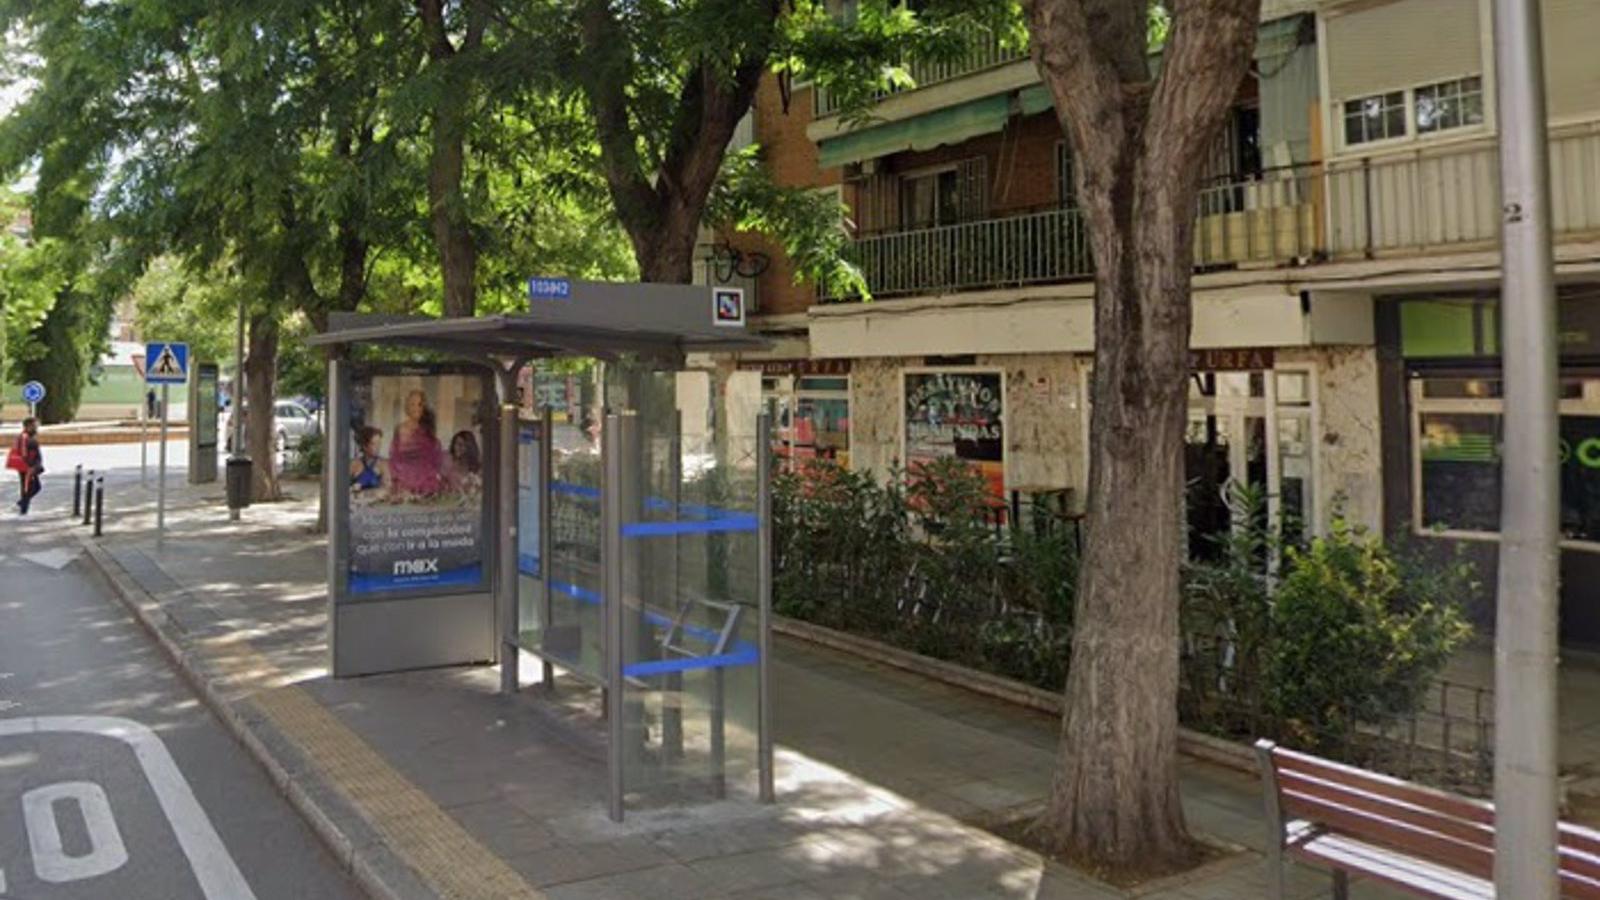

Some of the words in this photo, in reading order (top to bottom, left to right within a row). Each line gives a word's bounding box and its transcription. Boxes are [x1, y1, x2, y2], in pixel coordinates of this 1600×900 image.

[1503, 203, 1523, 223] 2
[388, 527, 399, 538] la
[356, 543, 380, 555] que
[428, 539, 440, 549] la
[441, 536, 475, 548] moda
[393, 558, 438, 575] max
